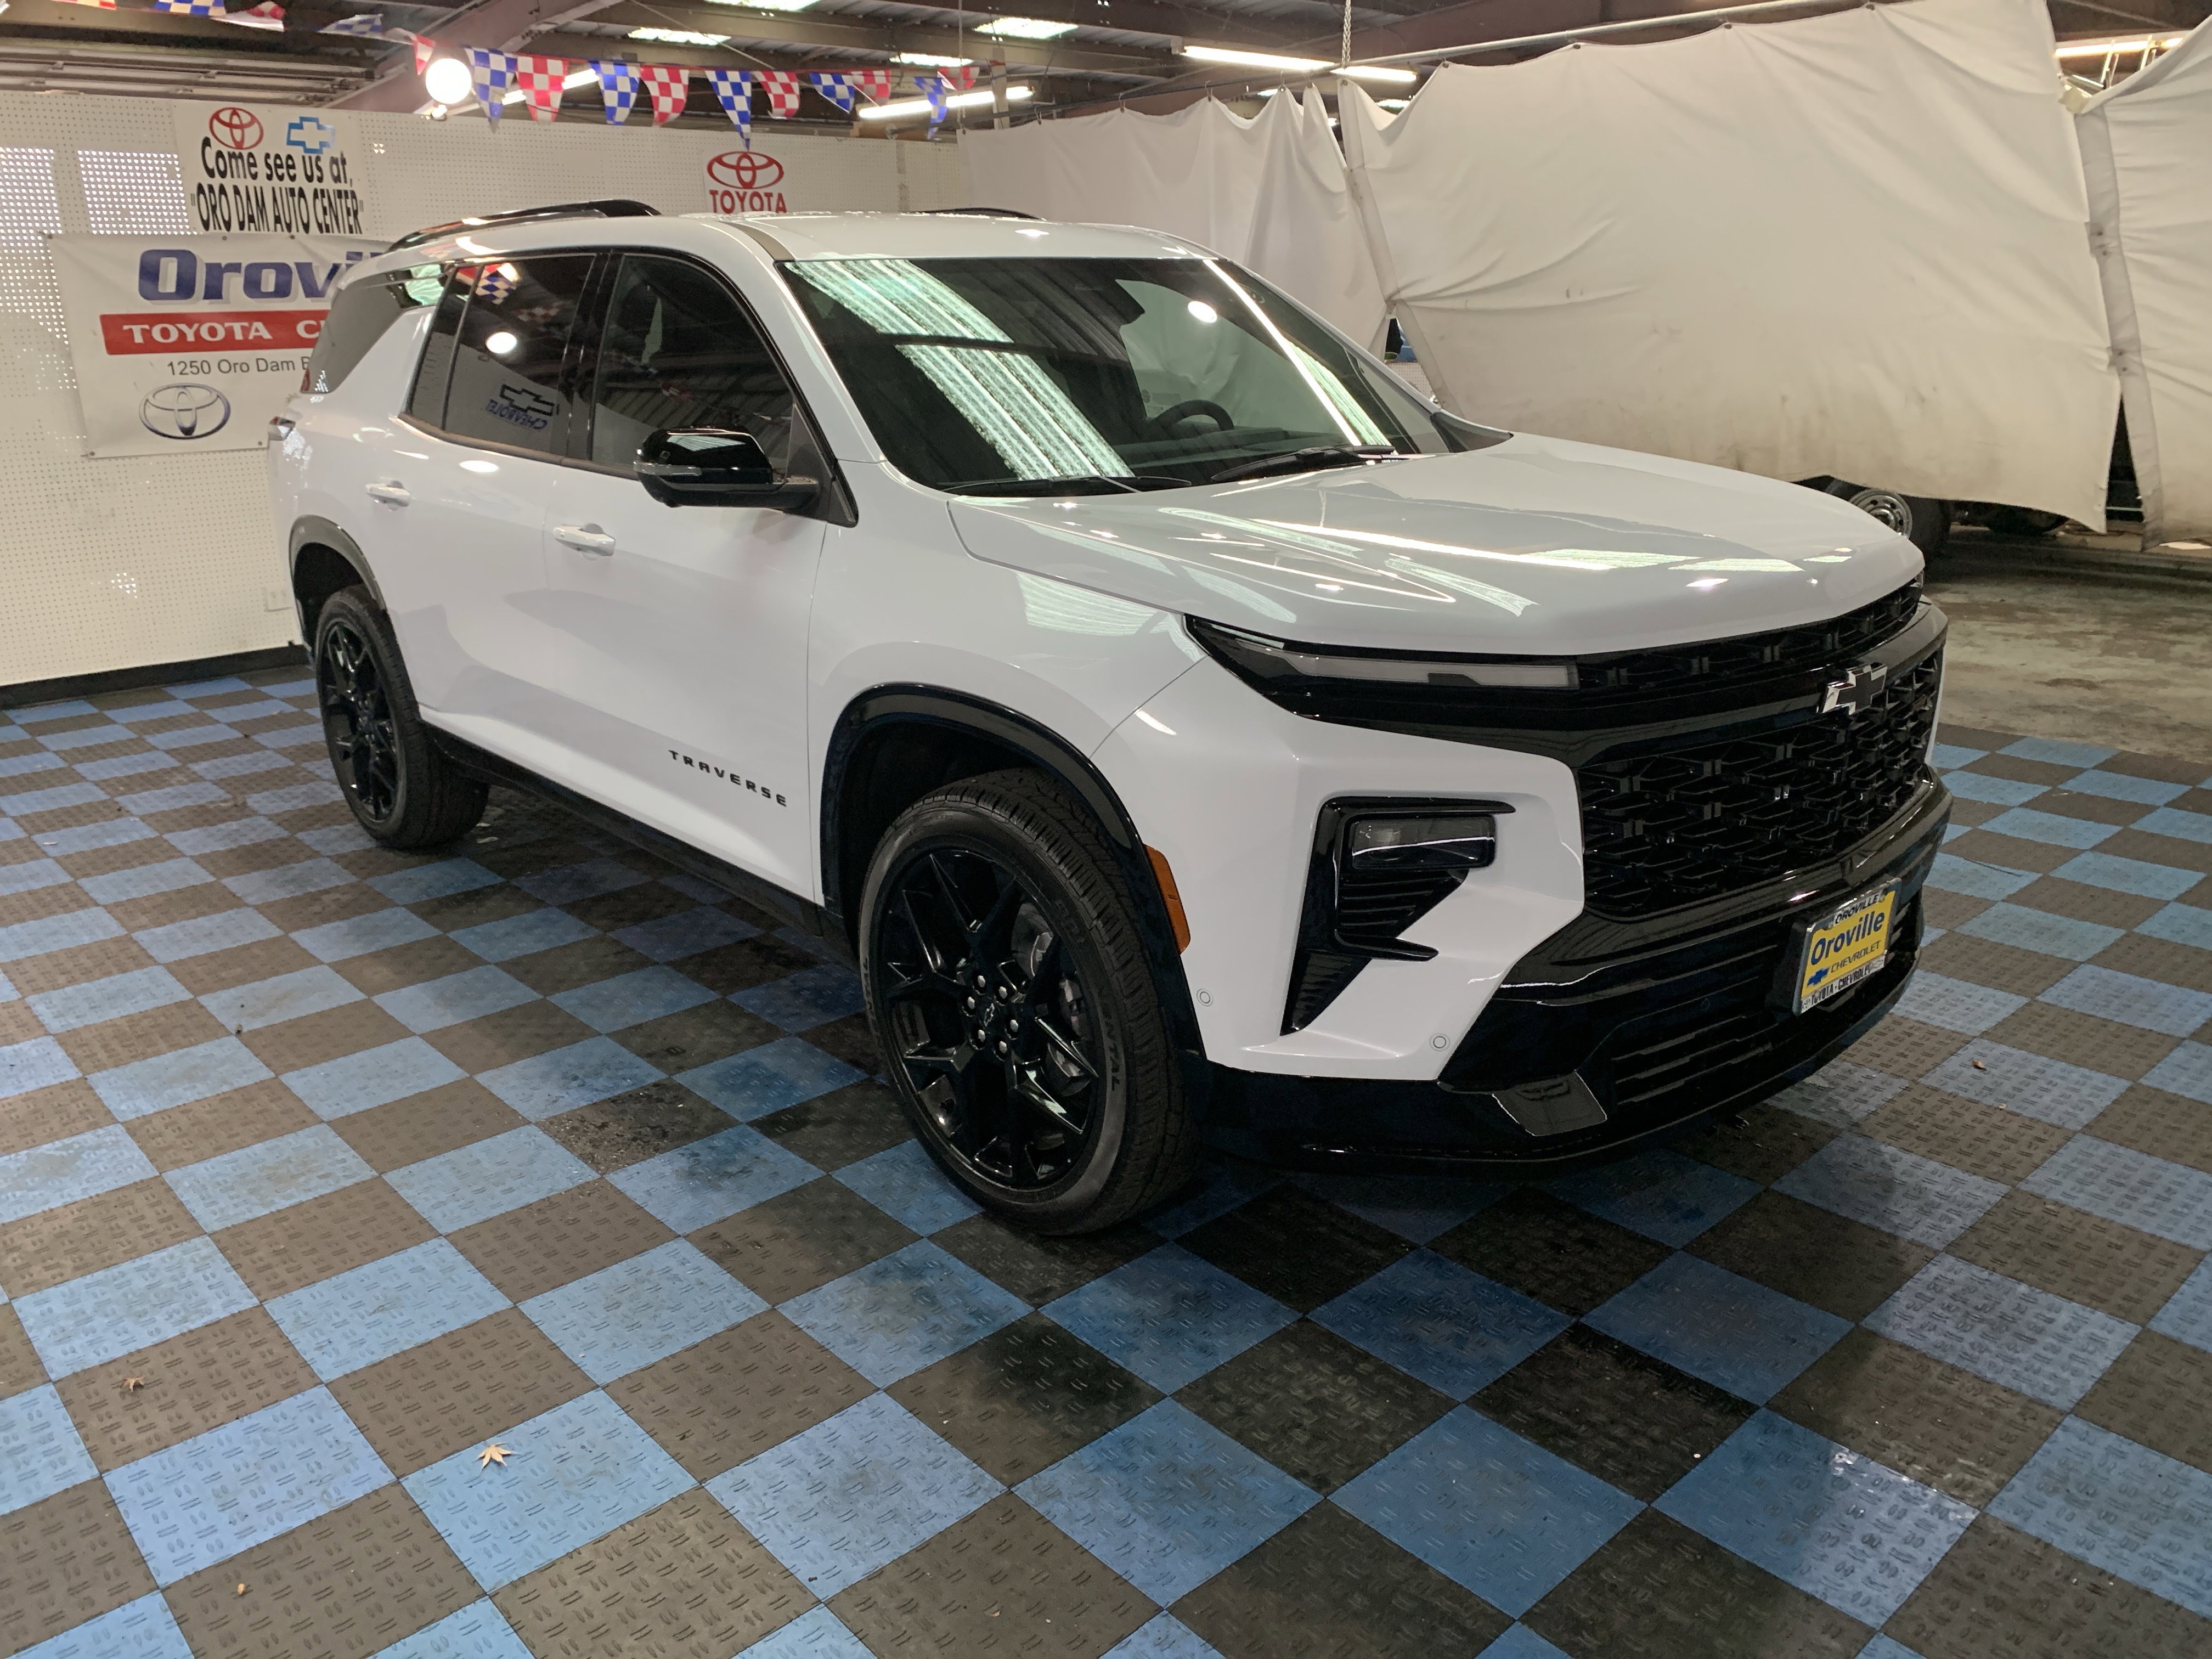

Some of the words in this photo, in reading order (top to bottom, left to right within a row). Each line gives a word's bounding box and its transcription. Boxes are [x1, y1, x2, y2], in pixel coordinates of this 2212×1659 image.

[201, 136, 258, 180] Come
[264, 153, 297, 182] see
[302, 155, 324, 183] us
[232, 184, 270, 232] DAM
[272, 186, 311, 234] AUTO
[709, 189, 787, 215] TOYOTA
[123, 321, 273, 343] TOYOTA
[167, 360, 211, 376] 1250
[218, 359, 250, 374] Oro
[256, 357, 296, 373] Dam
[668, 749, 787, 807] TRAVERSE
[1835, 894, 1880, 924] OROVILLE
[1811, 910, 1886, 965] Oroville
[1831, 940, 1881, 973] CHEVROLET
